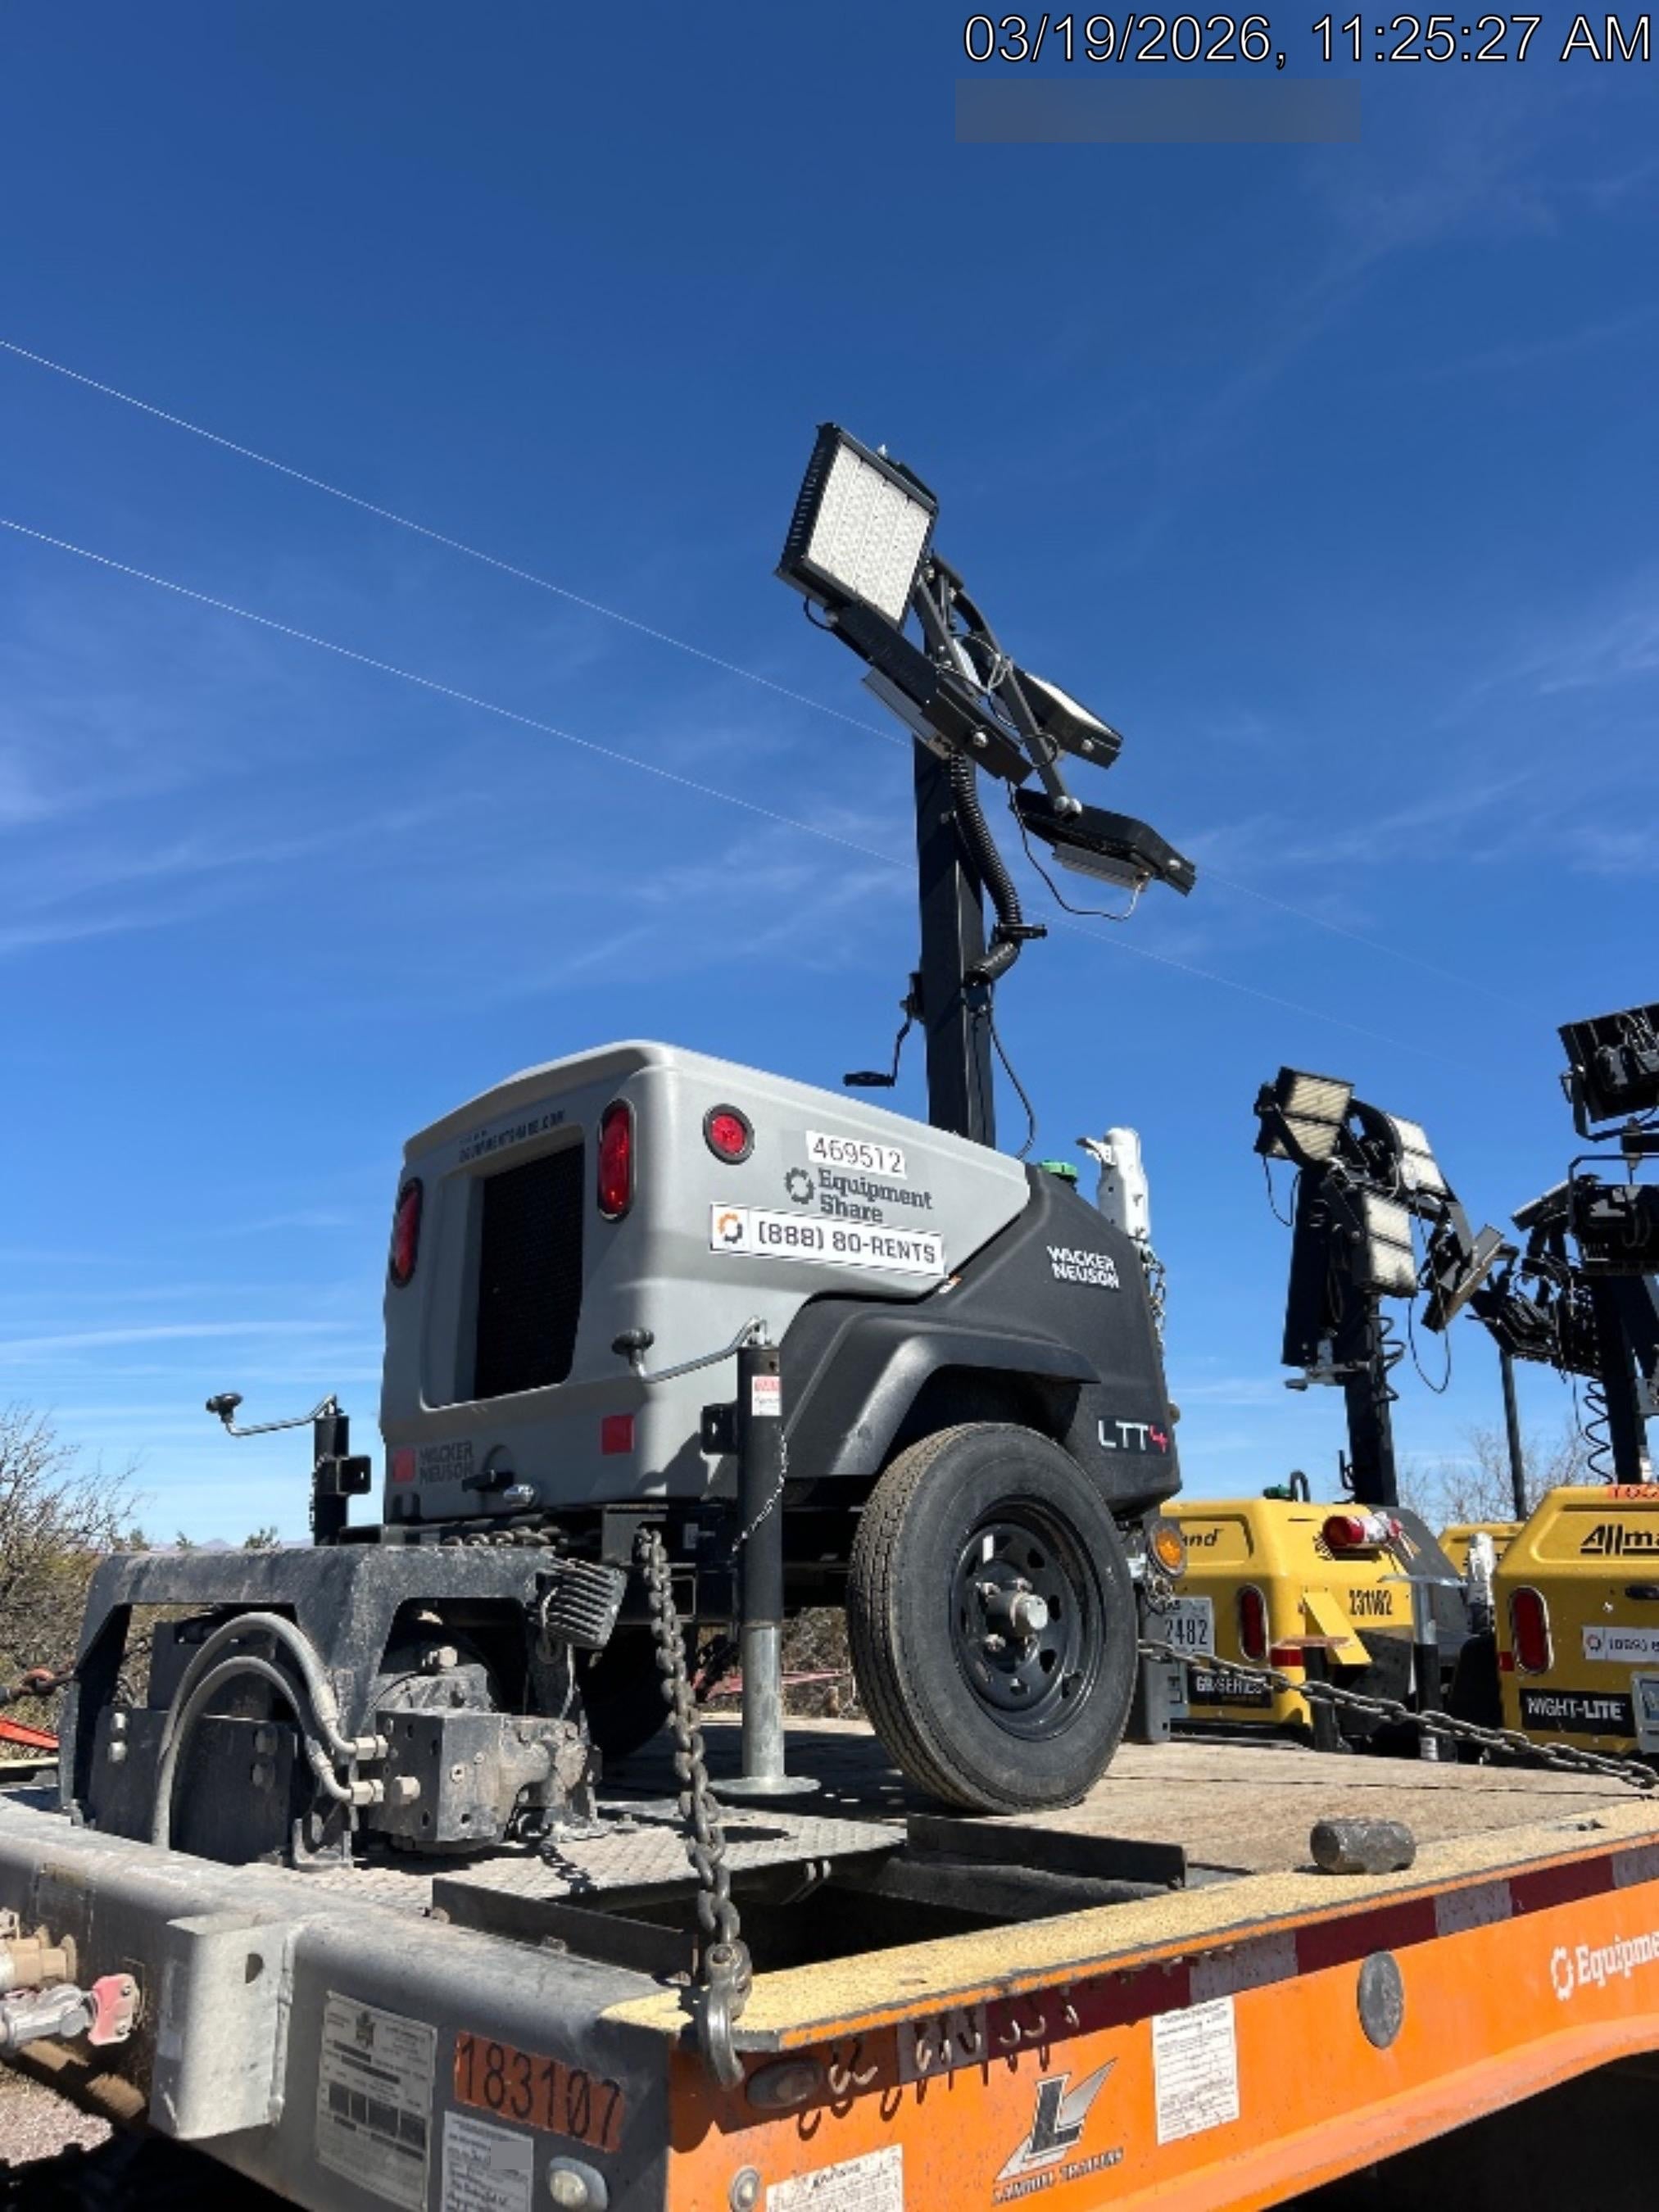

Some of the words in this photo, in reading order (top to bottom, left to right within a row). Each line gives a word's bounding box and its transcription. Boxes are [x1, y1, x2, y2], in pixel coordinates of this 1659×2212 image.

[813, 1137, 902, 1174] 469512
[818, 1167, 933, 1210] Equipment
[820, 1194, 883, 1224] Share
[758, 1221, 824, 1250] (888)
[832, 1231, 936, 1264] 80-RENTS
[1046, 1244, 1116, 1271] WACKER
[1052, 1262, 1120, 1290] NEUSON
[1097, 1419, 1168, 1454] LTT4
[1580, 1524, 1659, 1555] Allm
[461, 2036, 622, 2146] 183107
